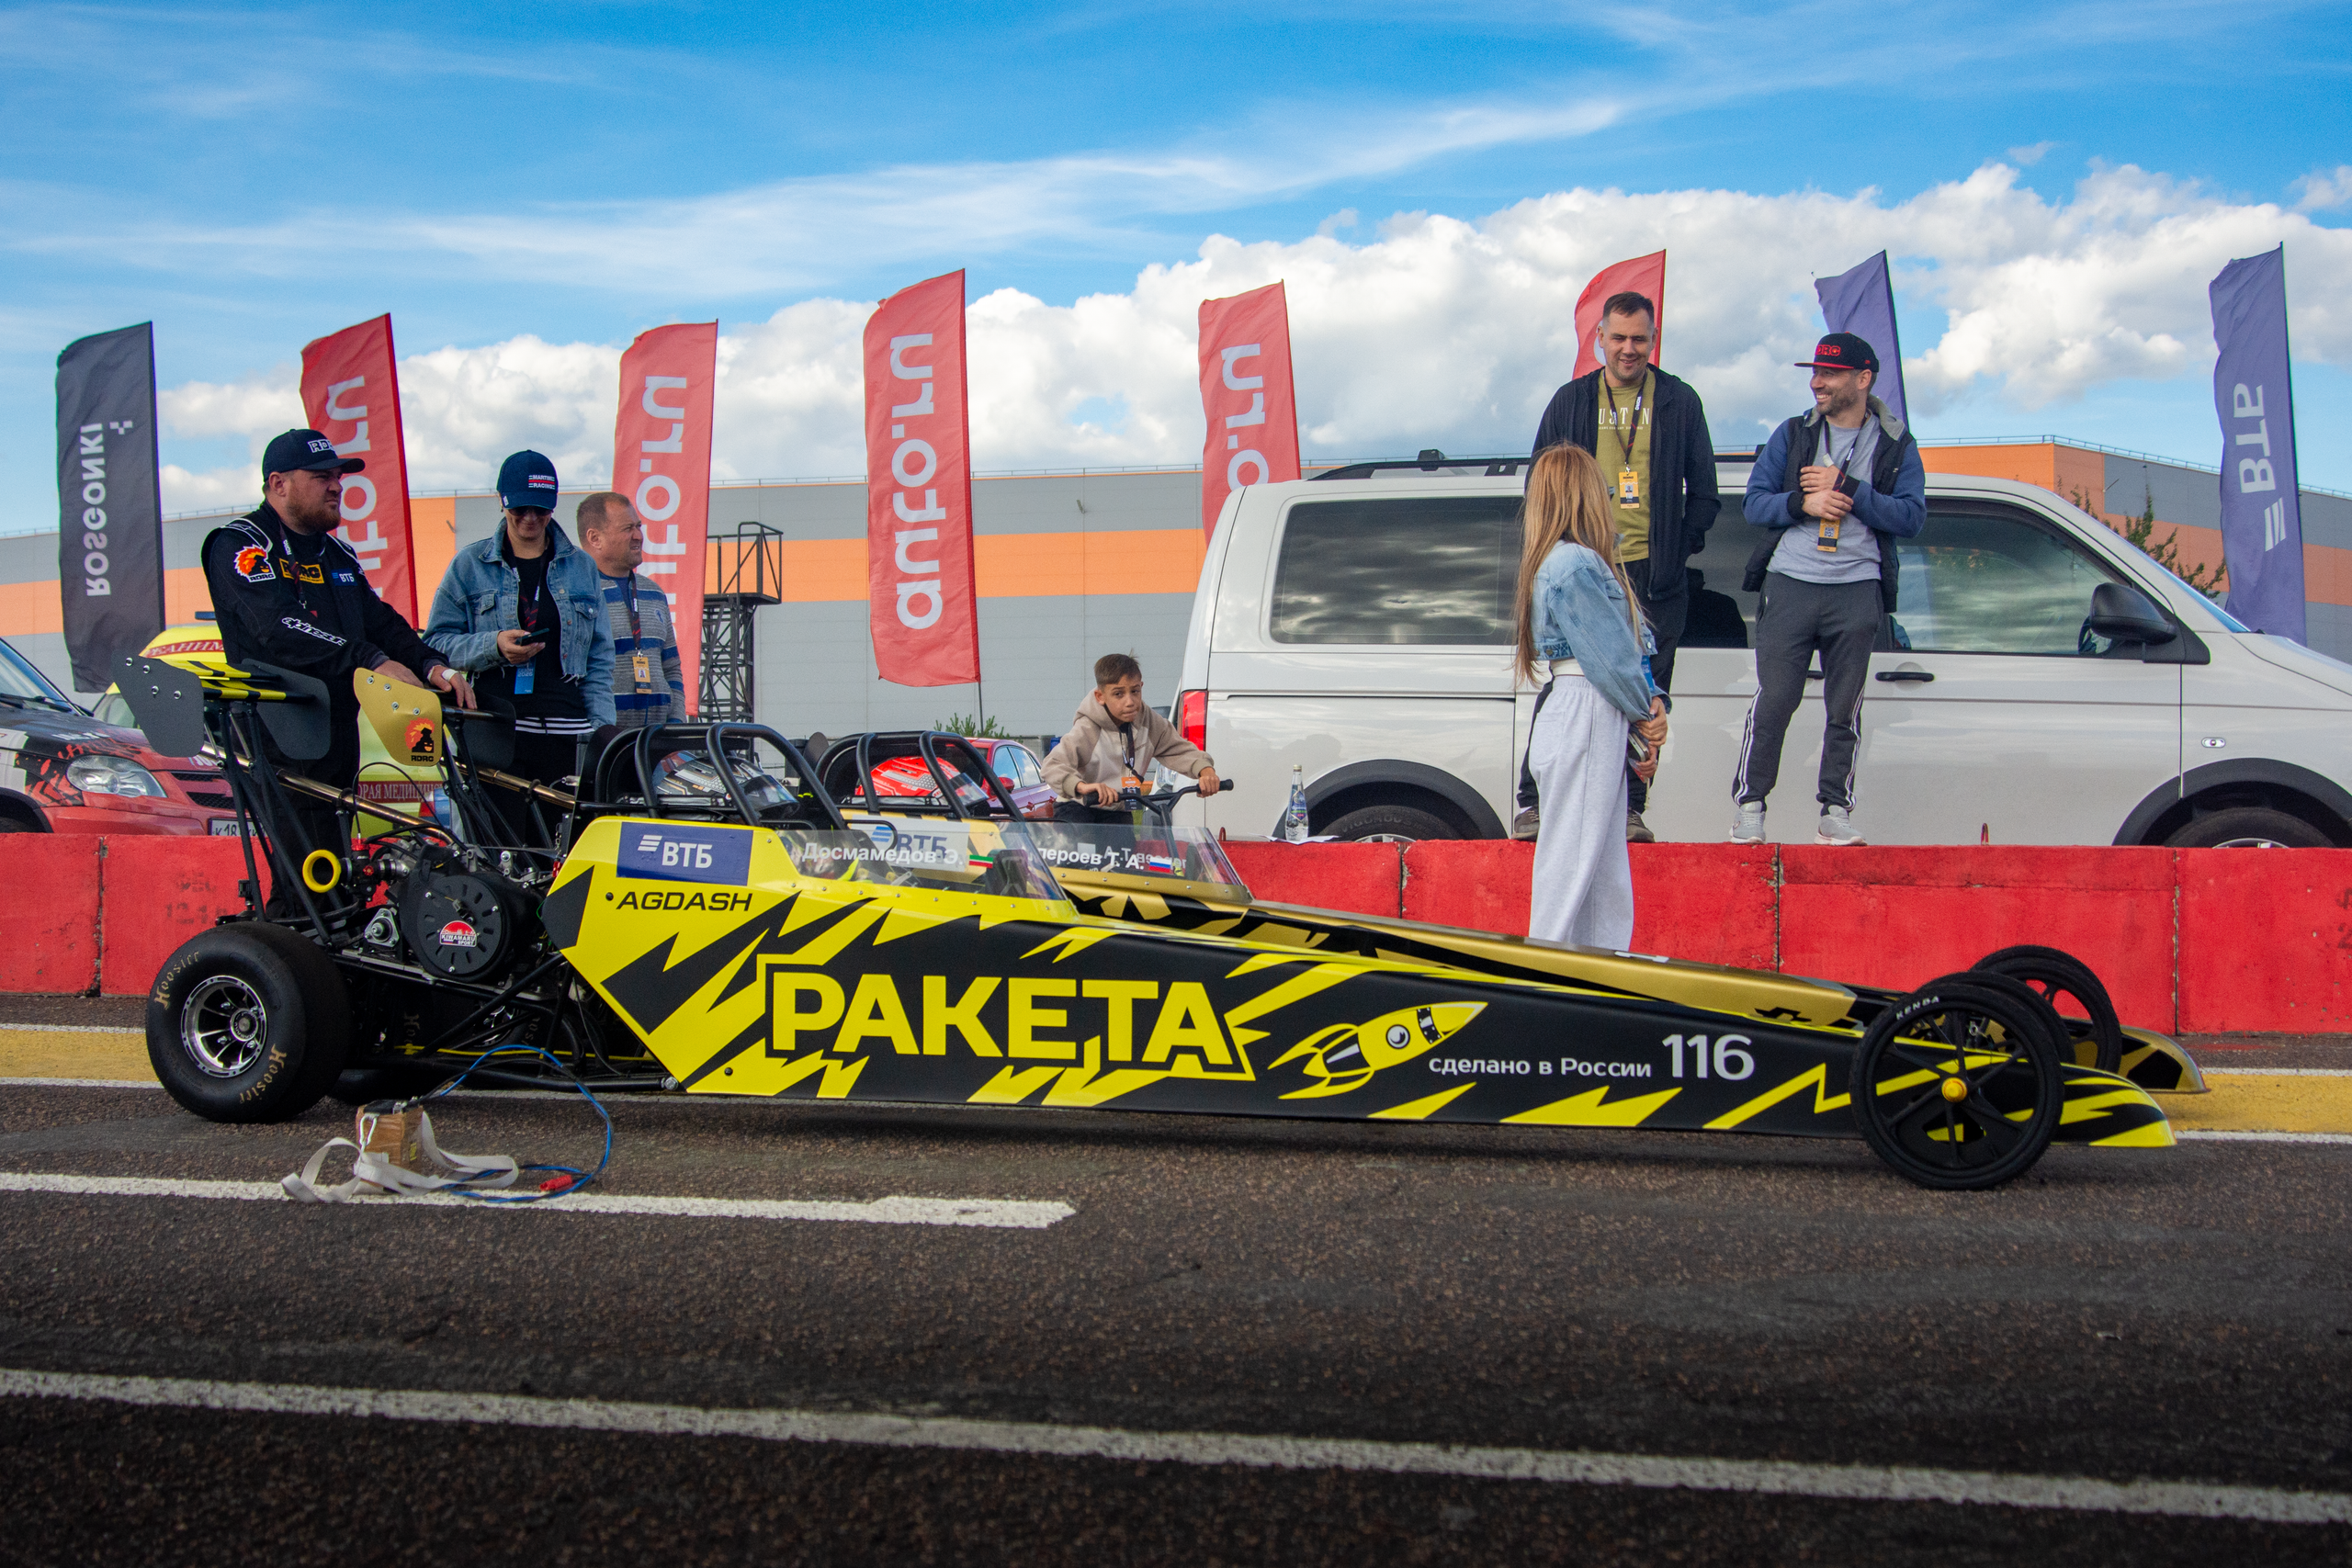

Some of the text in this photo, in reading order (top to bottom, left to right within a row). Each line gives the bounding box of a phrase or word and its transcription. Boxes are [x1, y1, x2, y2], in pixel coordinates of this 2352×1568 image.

[338, 572, 355, 582] ВТБ
[662, 841, 713, 869] ВТБ
[801, 842, 937, 864] Досмамедов
[616, 891, 753, 912] AGDASH
[772, 971, 1234, 1066] РАКЕТА
[1895, 995, 1939, 1021] KENDA
[1429, 1055, 1651, 1077] сделано в России
[1662, 1033, 1755, 1080] 116
